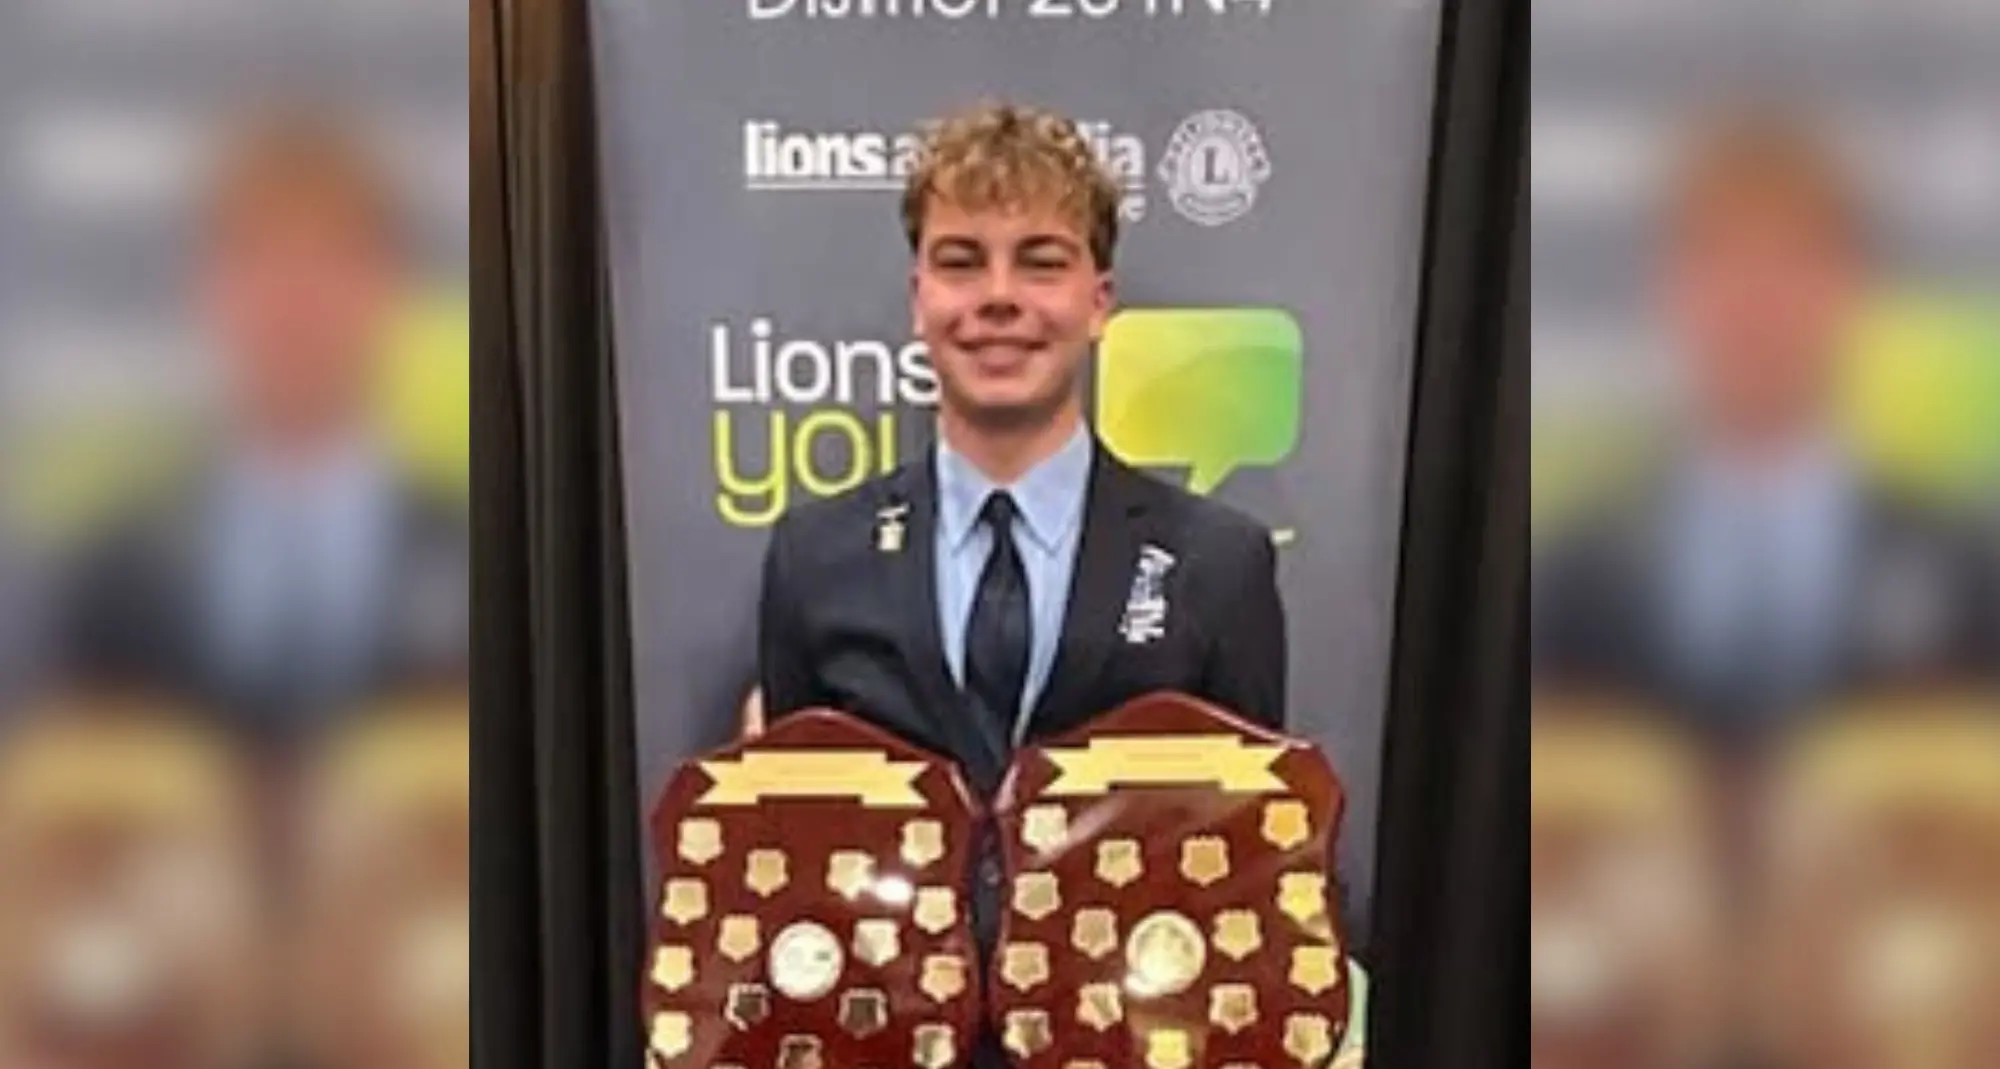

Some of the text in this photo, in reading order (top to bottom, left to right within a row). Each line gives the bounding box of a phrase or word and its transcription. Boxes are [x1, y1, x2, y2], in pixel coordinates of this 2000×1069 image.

[745, 121, 888, 177] lions
[1204, 146, 1230, 185] L
[713, 318, 943, 404] Lions
